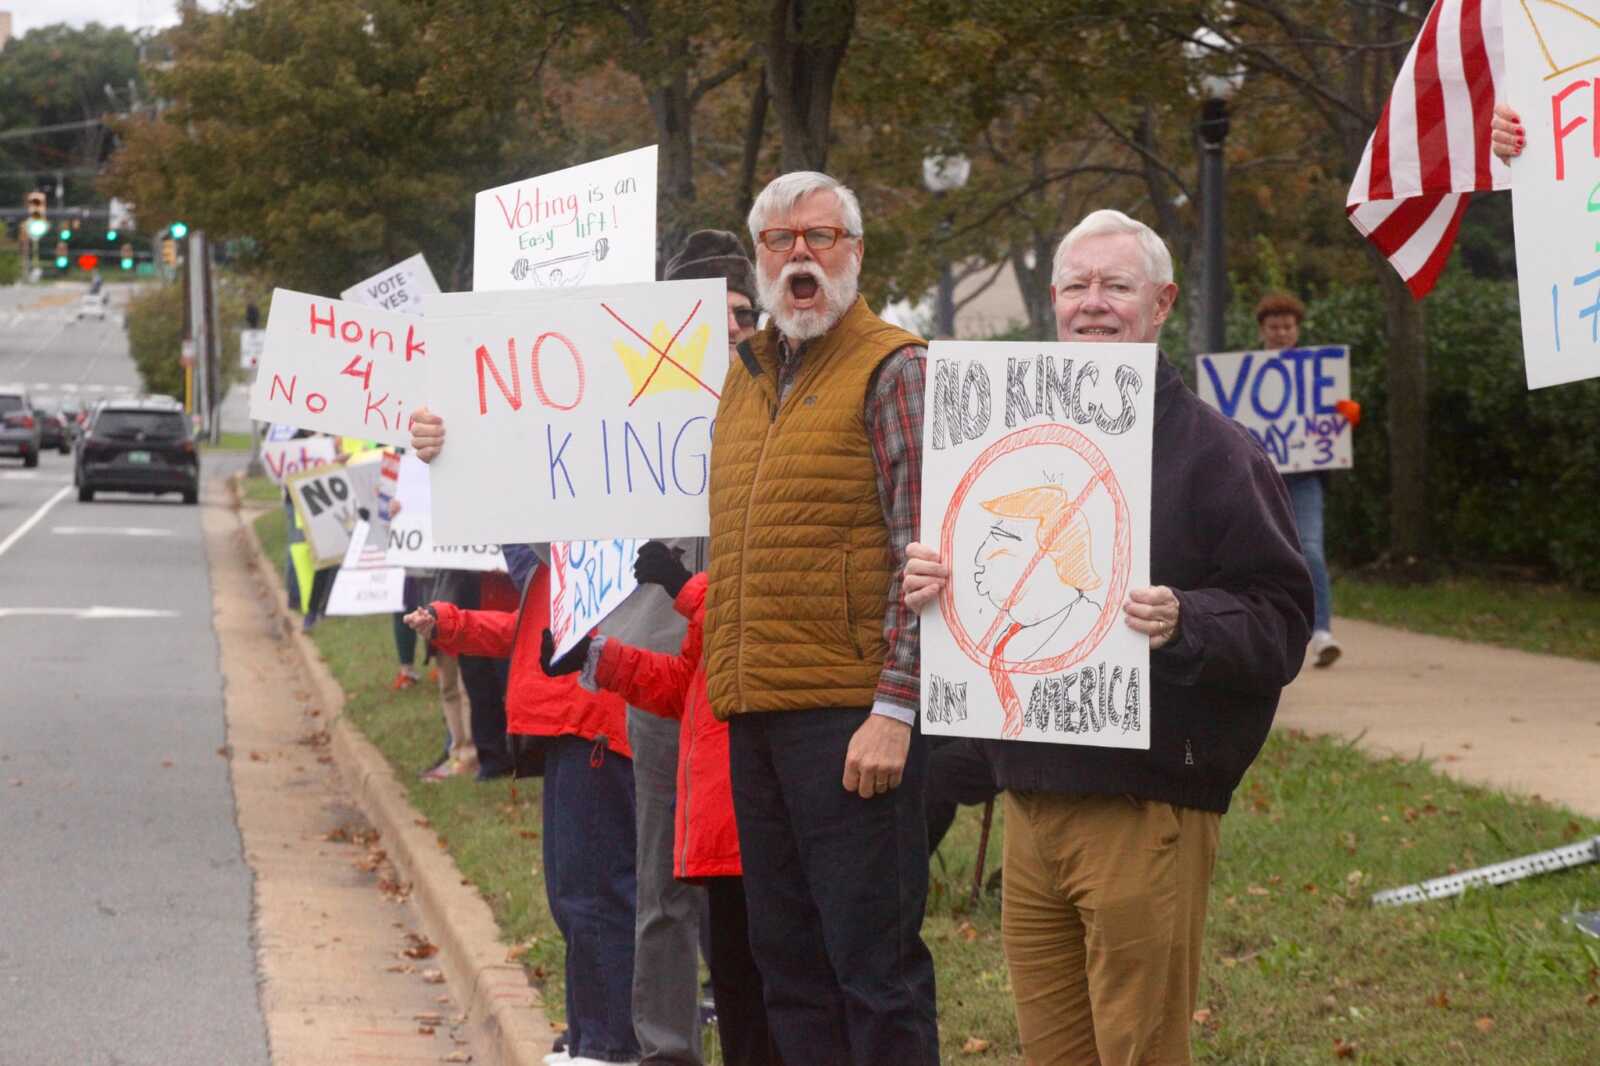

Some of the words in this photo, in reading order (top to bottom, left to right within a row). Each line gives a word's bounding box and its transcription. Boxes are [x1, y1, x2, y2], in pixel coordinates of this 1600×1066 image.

[495, 187, 580, 230] Voting
[588, 183, 604, 204] is
[614, 176, 637, 197] an
[518, 228, 555, 251] Easy
[367, 272, 407, 299] VOTE
[379, 289, 410, 311] YES
[309, 303, 425, 362] Honk
[340, 354, 374, 391] 4
[475, 331, 586, 416] NO
[1202, 347, 1346, 422] VOTE
[270, 373, 328, 414] No
[932, 357, 992, 450] NO
[1005, 354, 1143, 435] KINGS
[546, 415, 716, 500] KING
[1312, 438, 1334, 465] 3
[301, 476, 349, 516] NO
[388, 528, 423, 552] NO
[926, 672, 968, 724] IN
[1023, 661, 1141, 735] AMERICA
